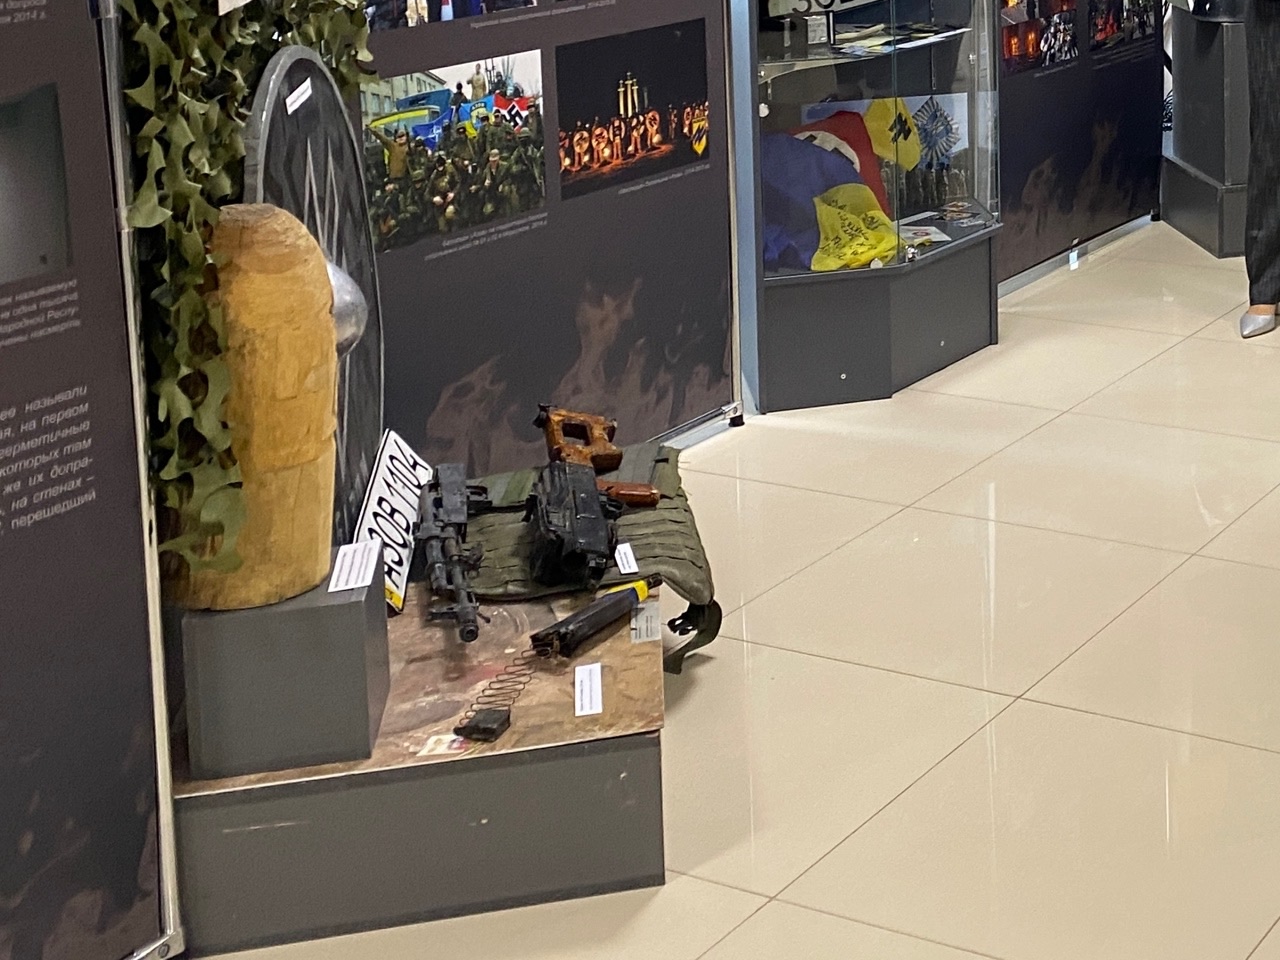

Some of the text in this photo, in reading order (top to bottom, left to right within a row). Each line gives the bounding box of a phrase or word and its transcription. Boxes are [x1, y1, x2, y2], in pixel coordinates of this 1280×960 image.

[25, 385, 88, 414] называли
[20, 419, 37, 433] на
[41, 402, 89, 426] первом
[63, 437, 92, 456] там
[28, 471, 44, 487] их
[50, 456, 93, 479] допра-
[11, 495, 28, 512] на
[32, 477, 82, 504] стенах
[11, 488, 96, 530] перешедший
